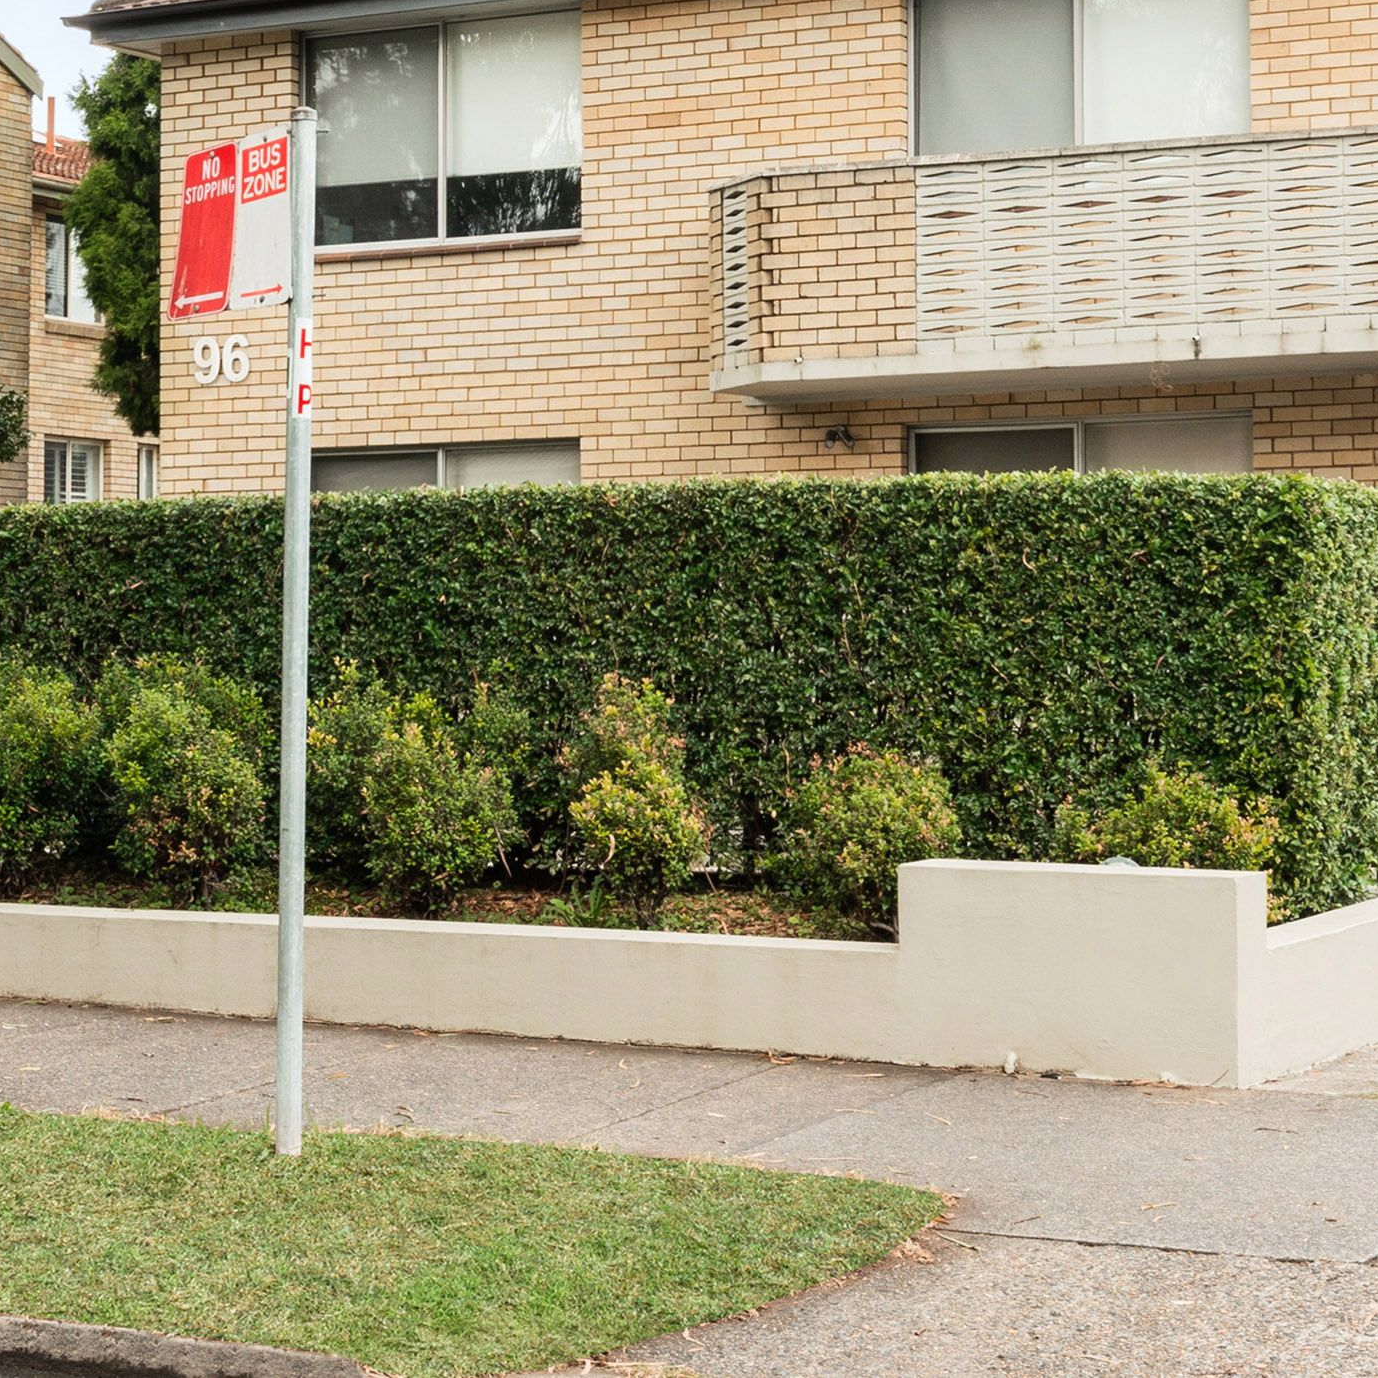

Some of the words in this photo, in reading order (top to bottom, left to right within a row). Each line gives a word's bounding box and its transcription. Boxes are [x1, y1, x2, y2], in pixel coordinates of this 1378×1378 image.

[202, 156, 220, 181] NO
[249, 143, 281, 173] BUS
[185, 176, 235, 205] STOPPING
[243, 167, 286, 199] ZONE
[193, 333, 250, 385] 96
